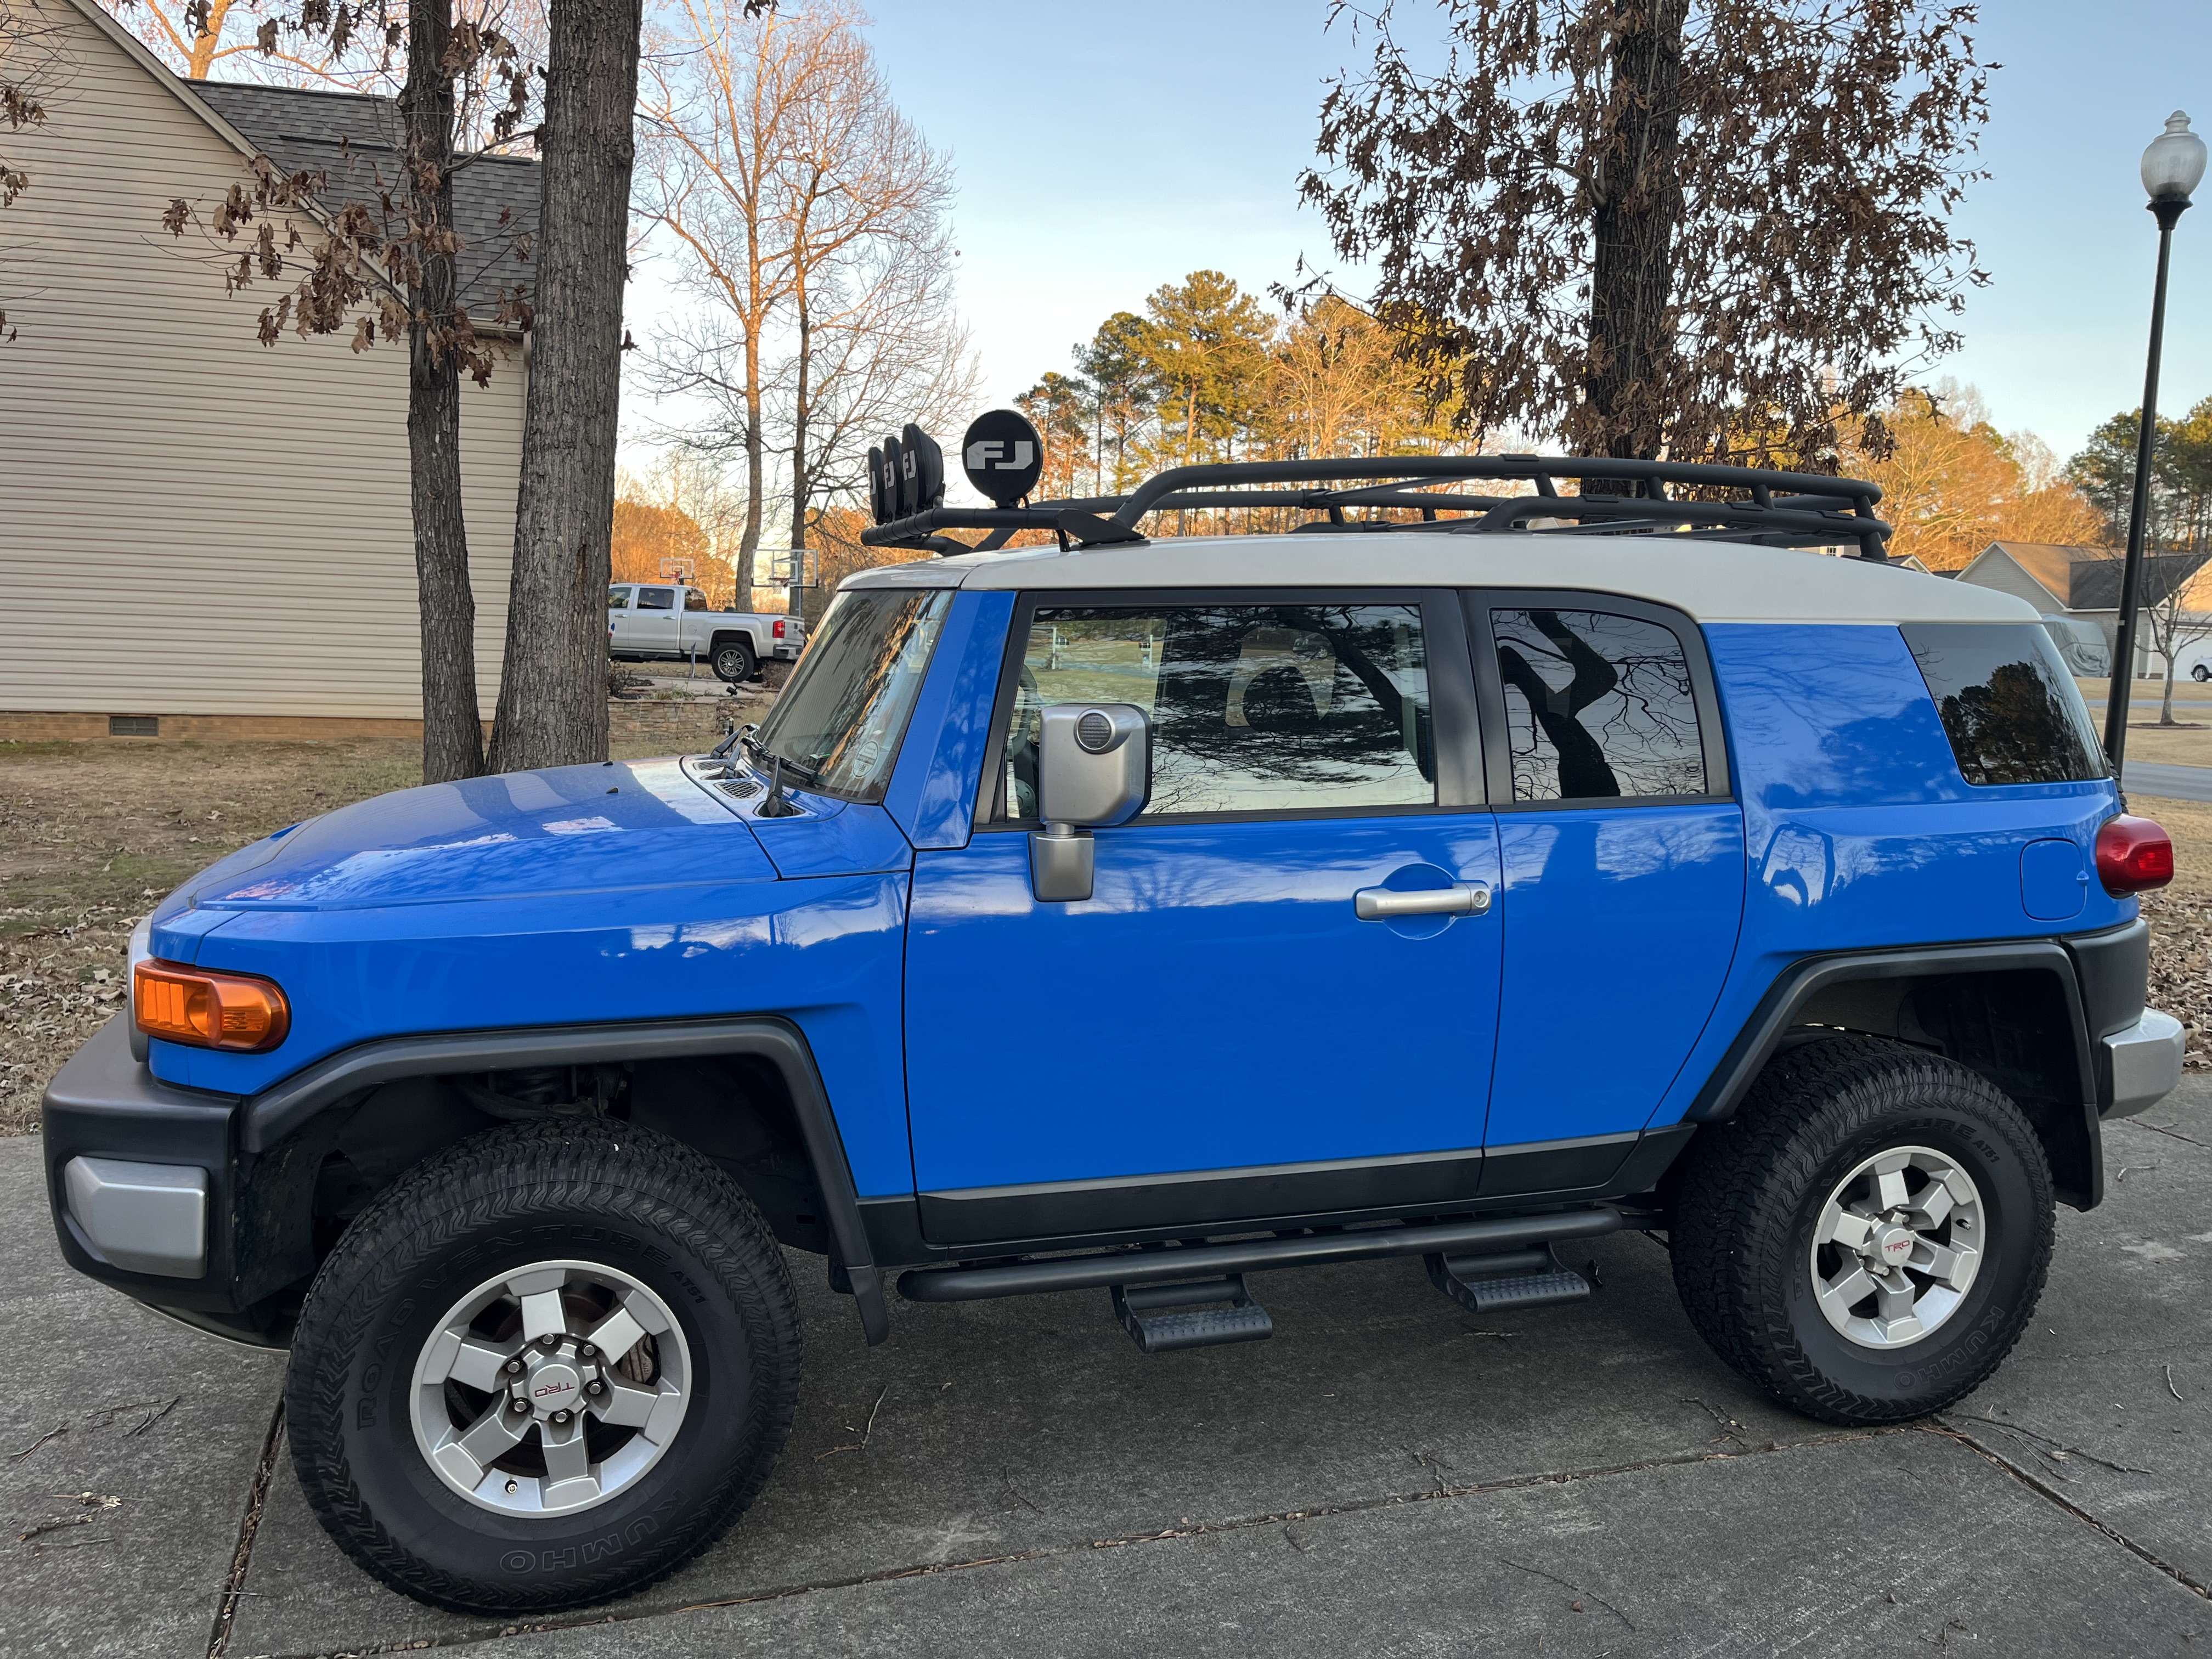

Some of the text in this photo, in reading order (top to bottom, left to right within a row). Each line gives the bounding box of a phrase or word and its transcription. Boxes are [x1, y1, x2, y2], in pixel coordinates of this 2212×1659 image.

[902, 450, 917, 481] FJ
[966, 441, 1033, 470] FJ
[883, 461, 895, 490] FJ
[1972, 1139, 2000, 1163] AT51
[1884, 1240, 1910, 1252] TRD
[357, 1223, 707, 1431] ROAD VENTURE AT51
[1894, 1305, 2006, 1390] KUMHO
[534, 1382, 575, 1397] TRD
[499, 1488, 692, 1575] KUMHO
